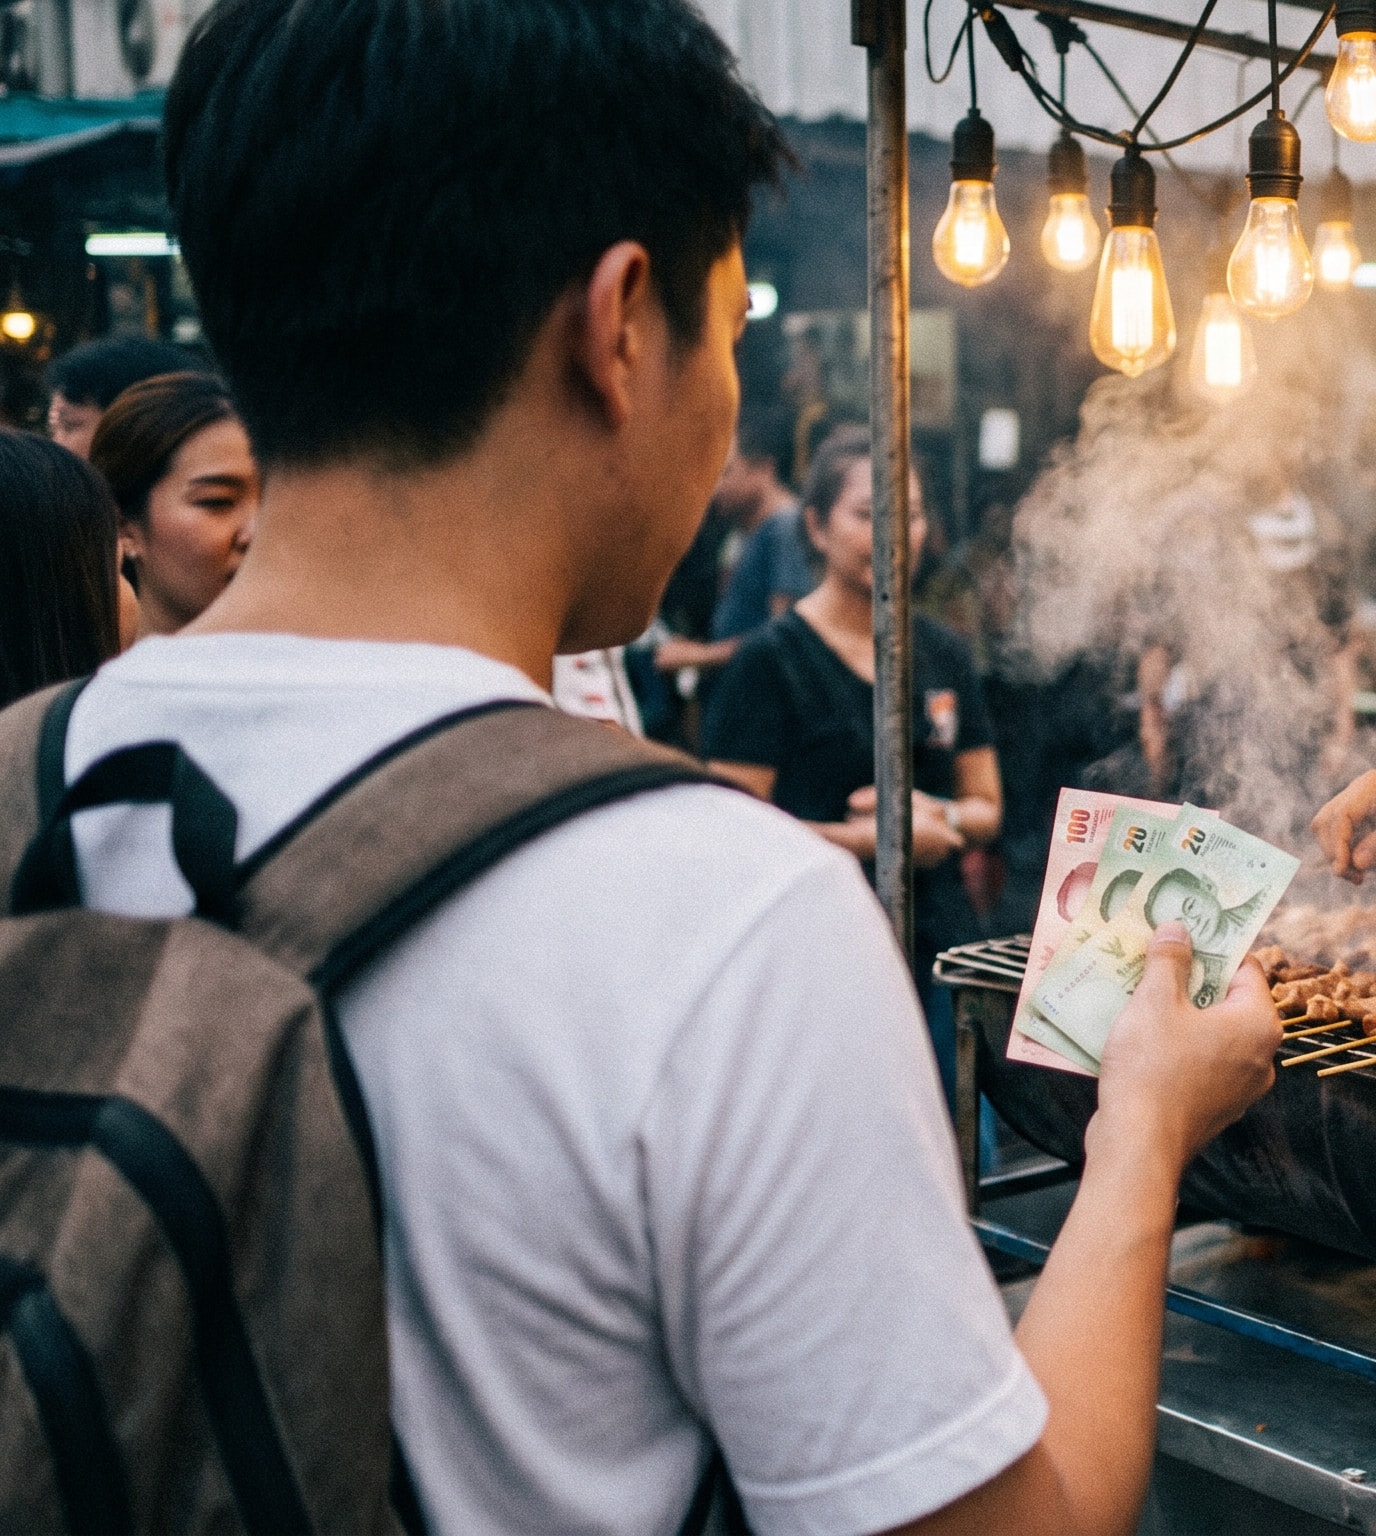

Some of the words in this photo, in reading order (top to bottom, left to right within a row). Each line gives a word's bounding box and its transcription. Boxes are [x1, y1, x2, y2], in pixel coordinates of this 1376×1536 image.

[1066, 808, 1091, 844] 100
[1122, 825, 1148, 854] 20
[1180, 826, 1207, 856] 20
